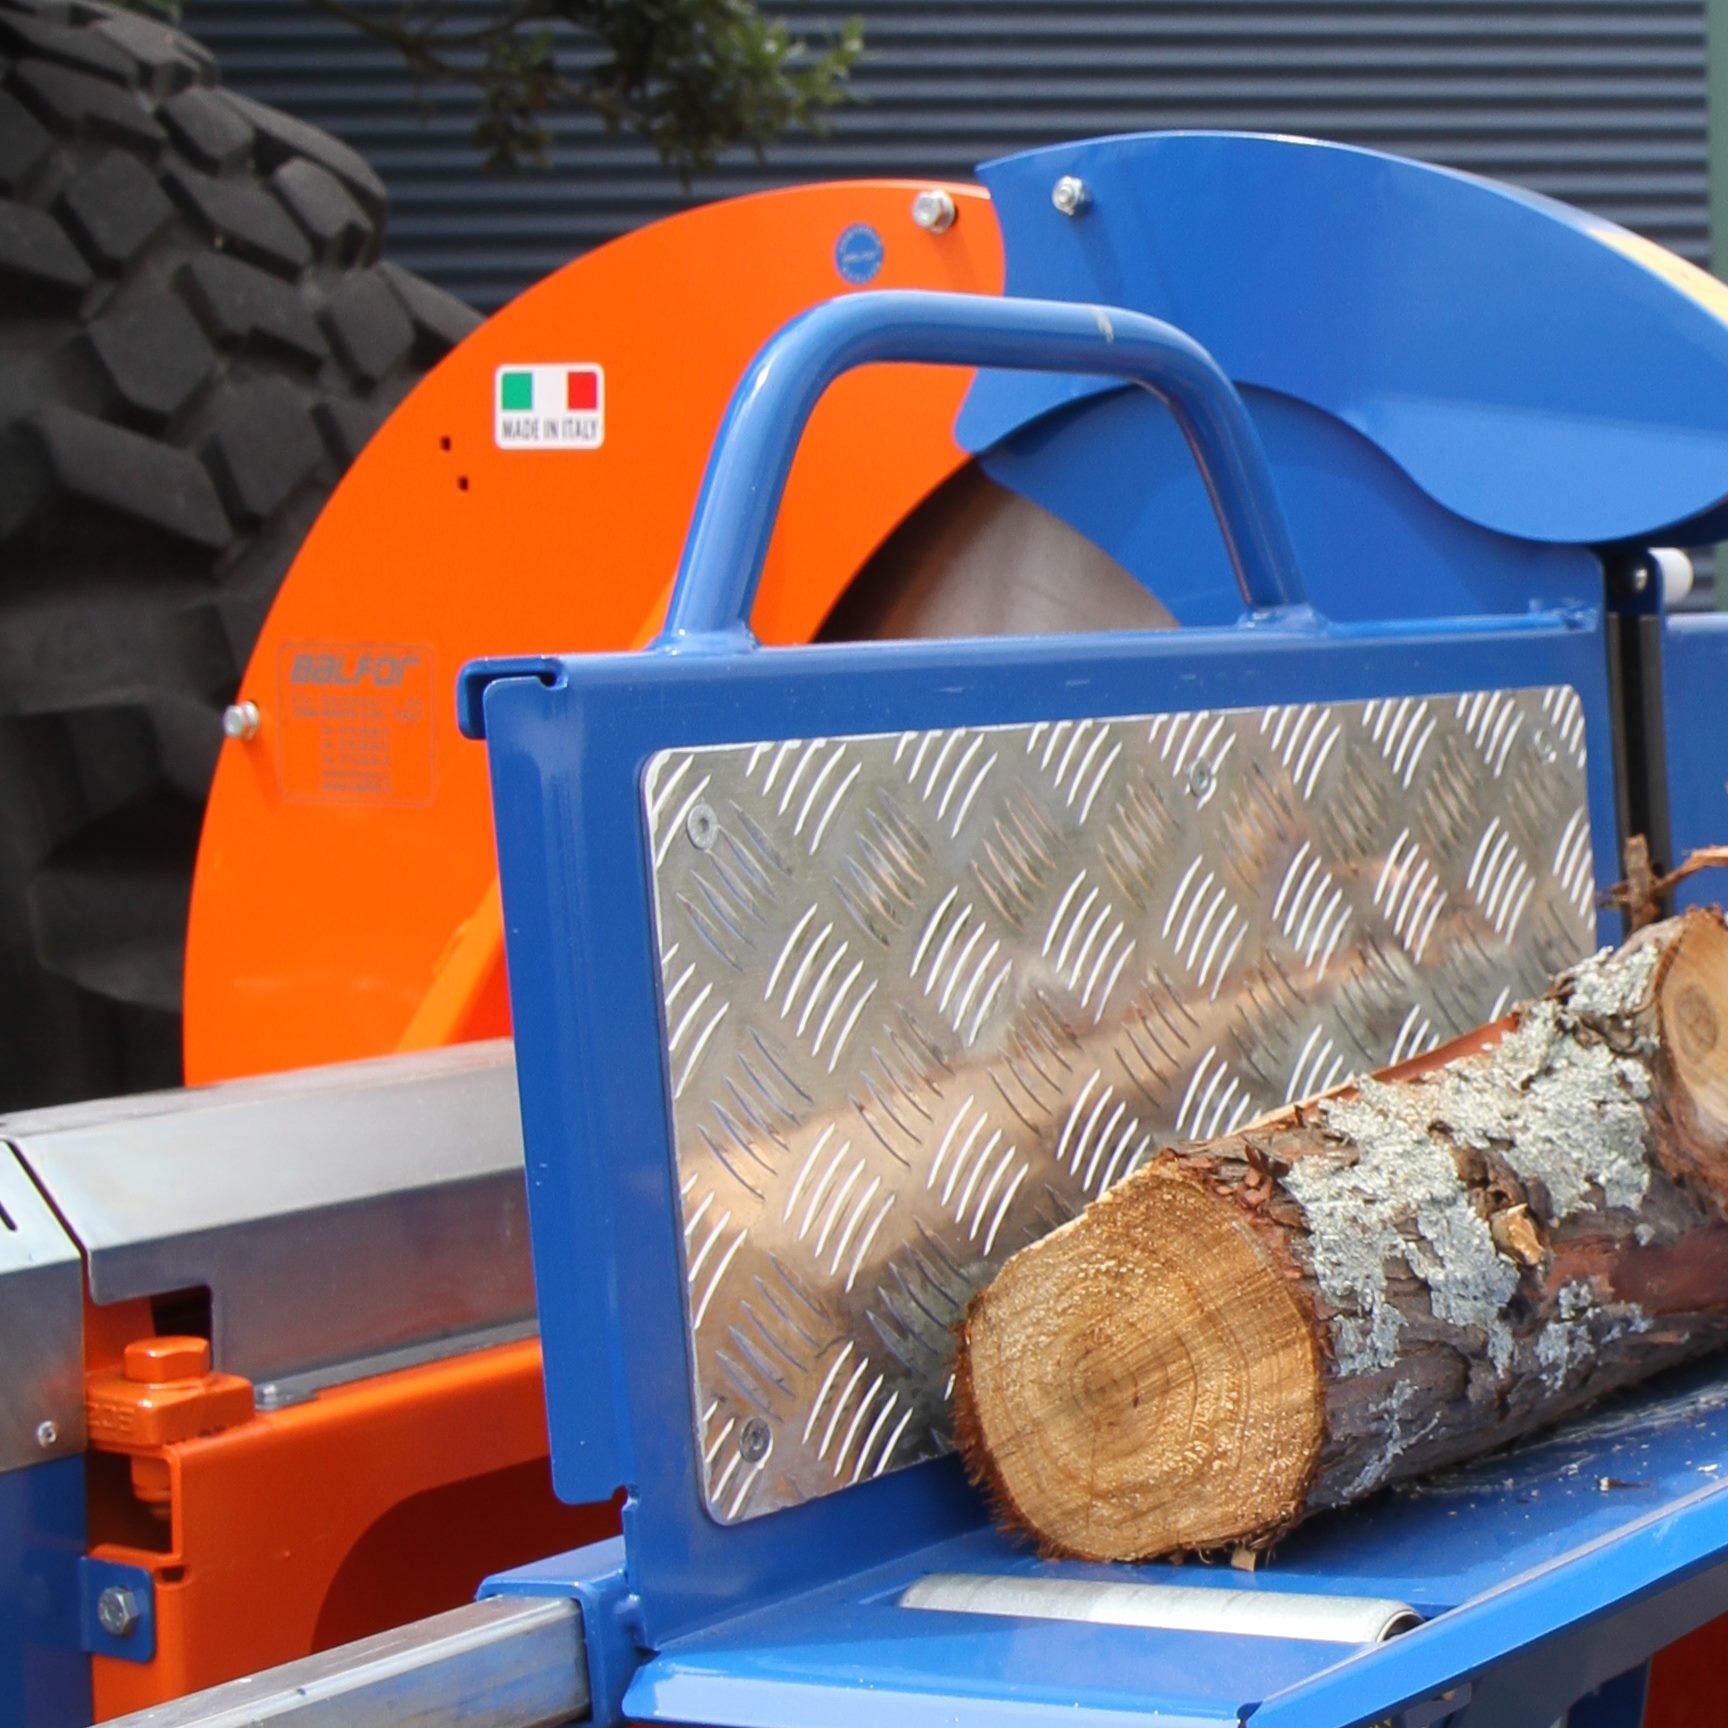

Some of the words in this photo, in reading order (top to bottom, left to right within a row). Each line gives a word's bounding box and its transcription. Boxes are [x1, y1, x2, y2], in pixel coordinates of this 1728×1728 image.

[502, 417, 539, 441] MADE
[543, 417, 559, 440] IN
[562, 417, 597, 440] ITALY
